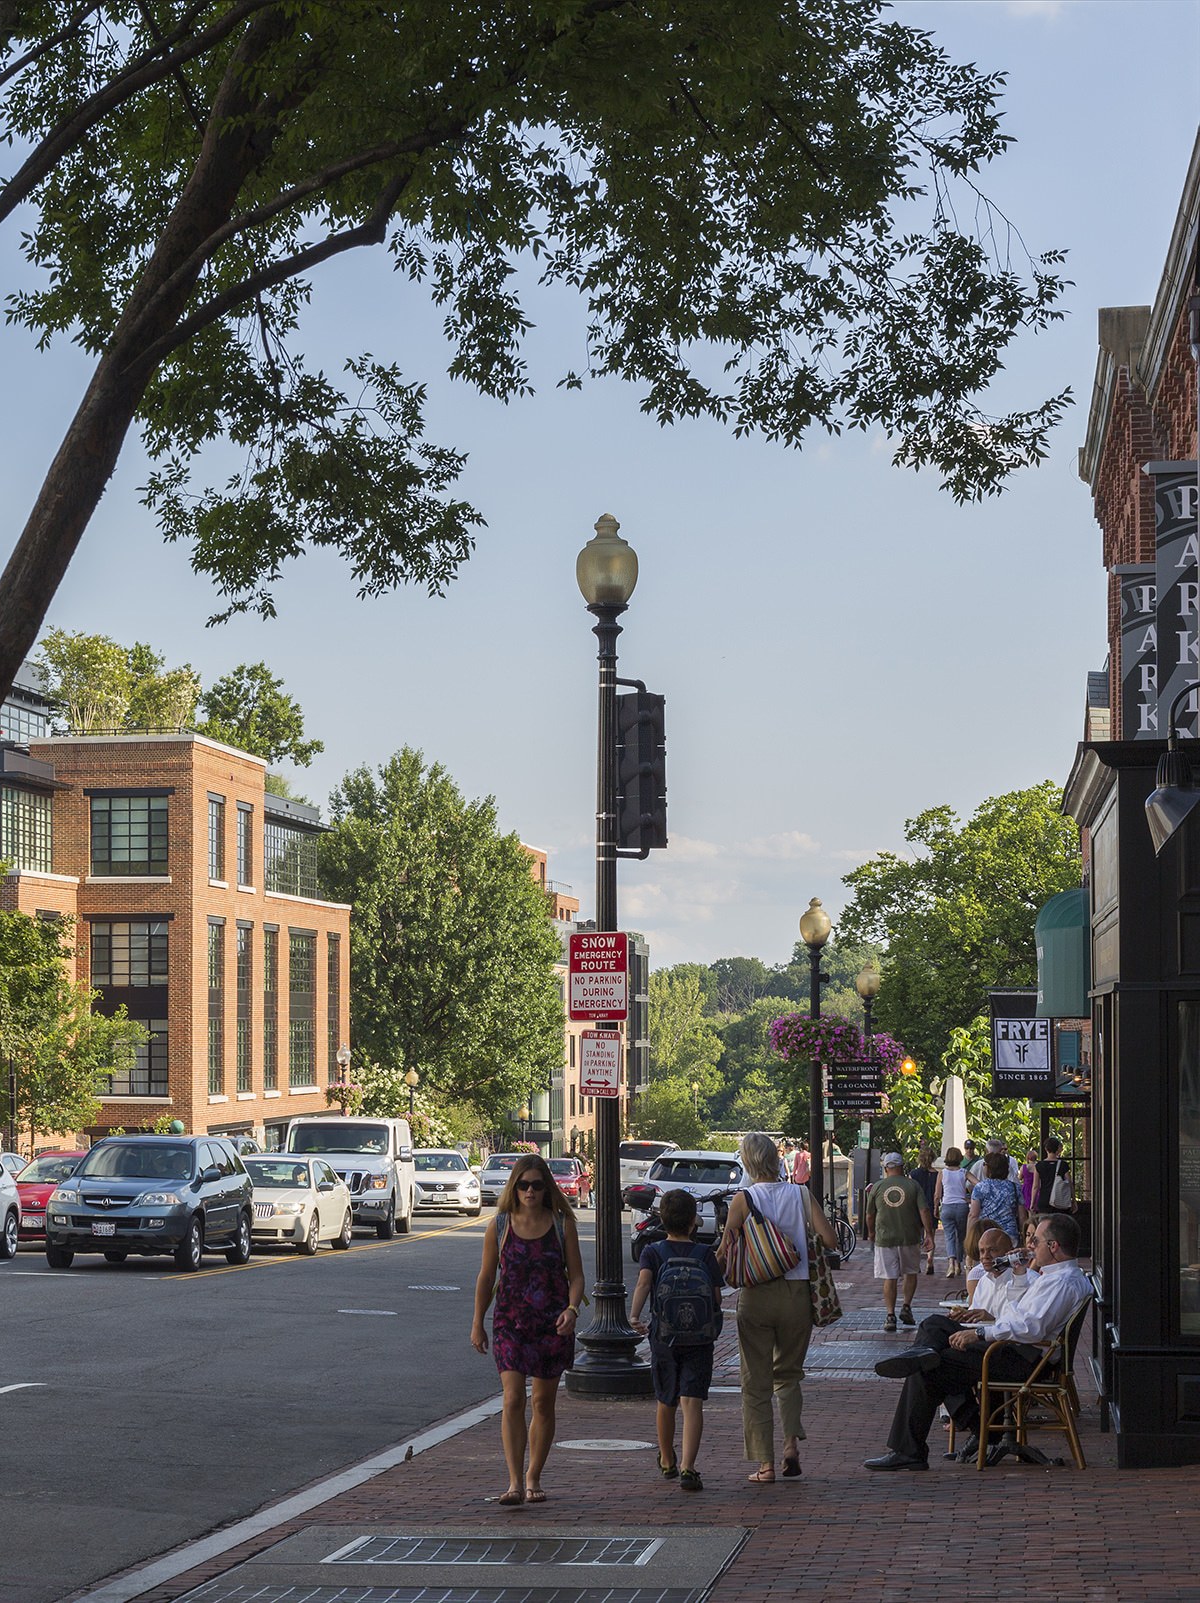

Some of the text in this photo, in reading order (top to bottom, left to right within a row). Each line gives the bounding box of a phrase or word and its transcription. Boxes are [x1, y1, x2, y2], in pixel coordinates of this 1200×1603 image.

[581, 937, 616, 948] SNOW
[574, 950, 623, 959] EMERGENCY
[581, 960, 616, 970] ROUTE
[574, 976, 622, 985] NO PARKING
[582, 988, 614, 996] DURING
[573, 999, 623, 1008] EMERGENCY
[996, 1020, 1048, 1040] FRYE
[595, 1041, 606, 1049] NO
[586, 1050, 615, 1058] STANDING
